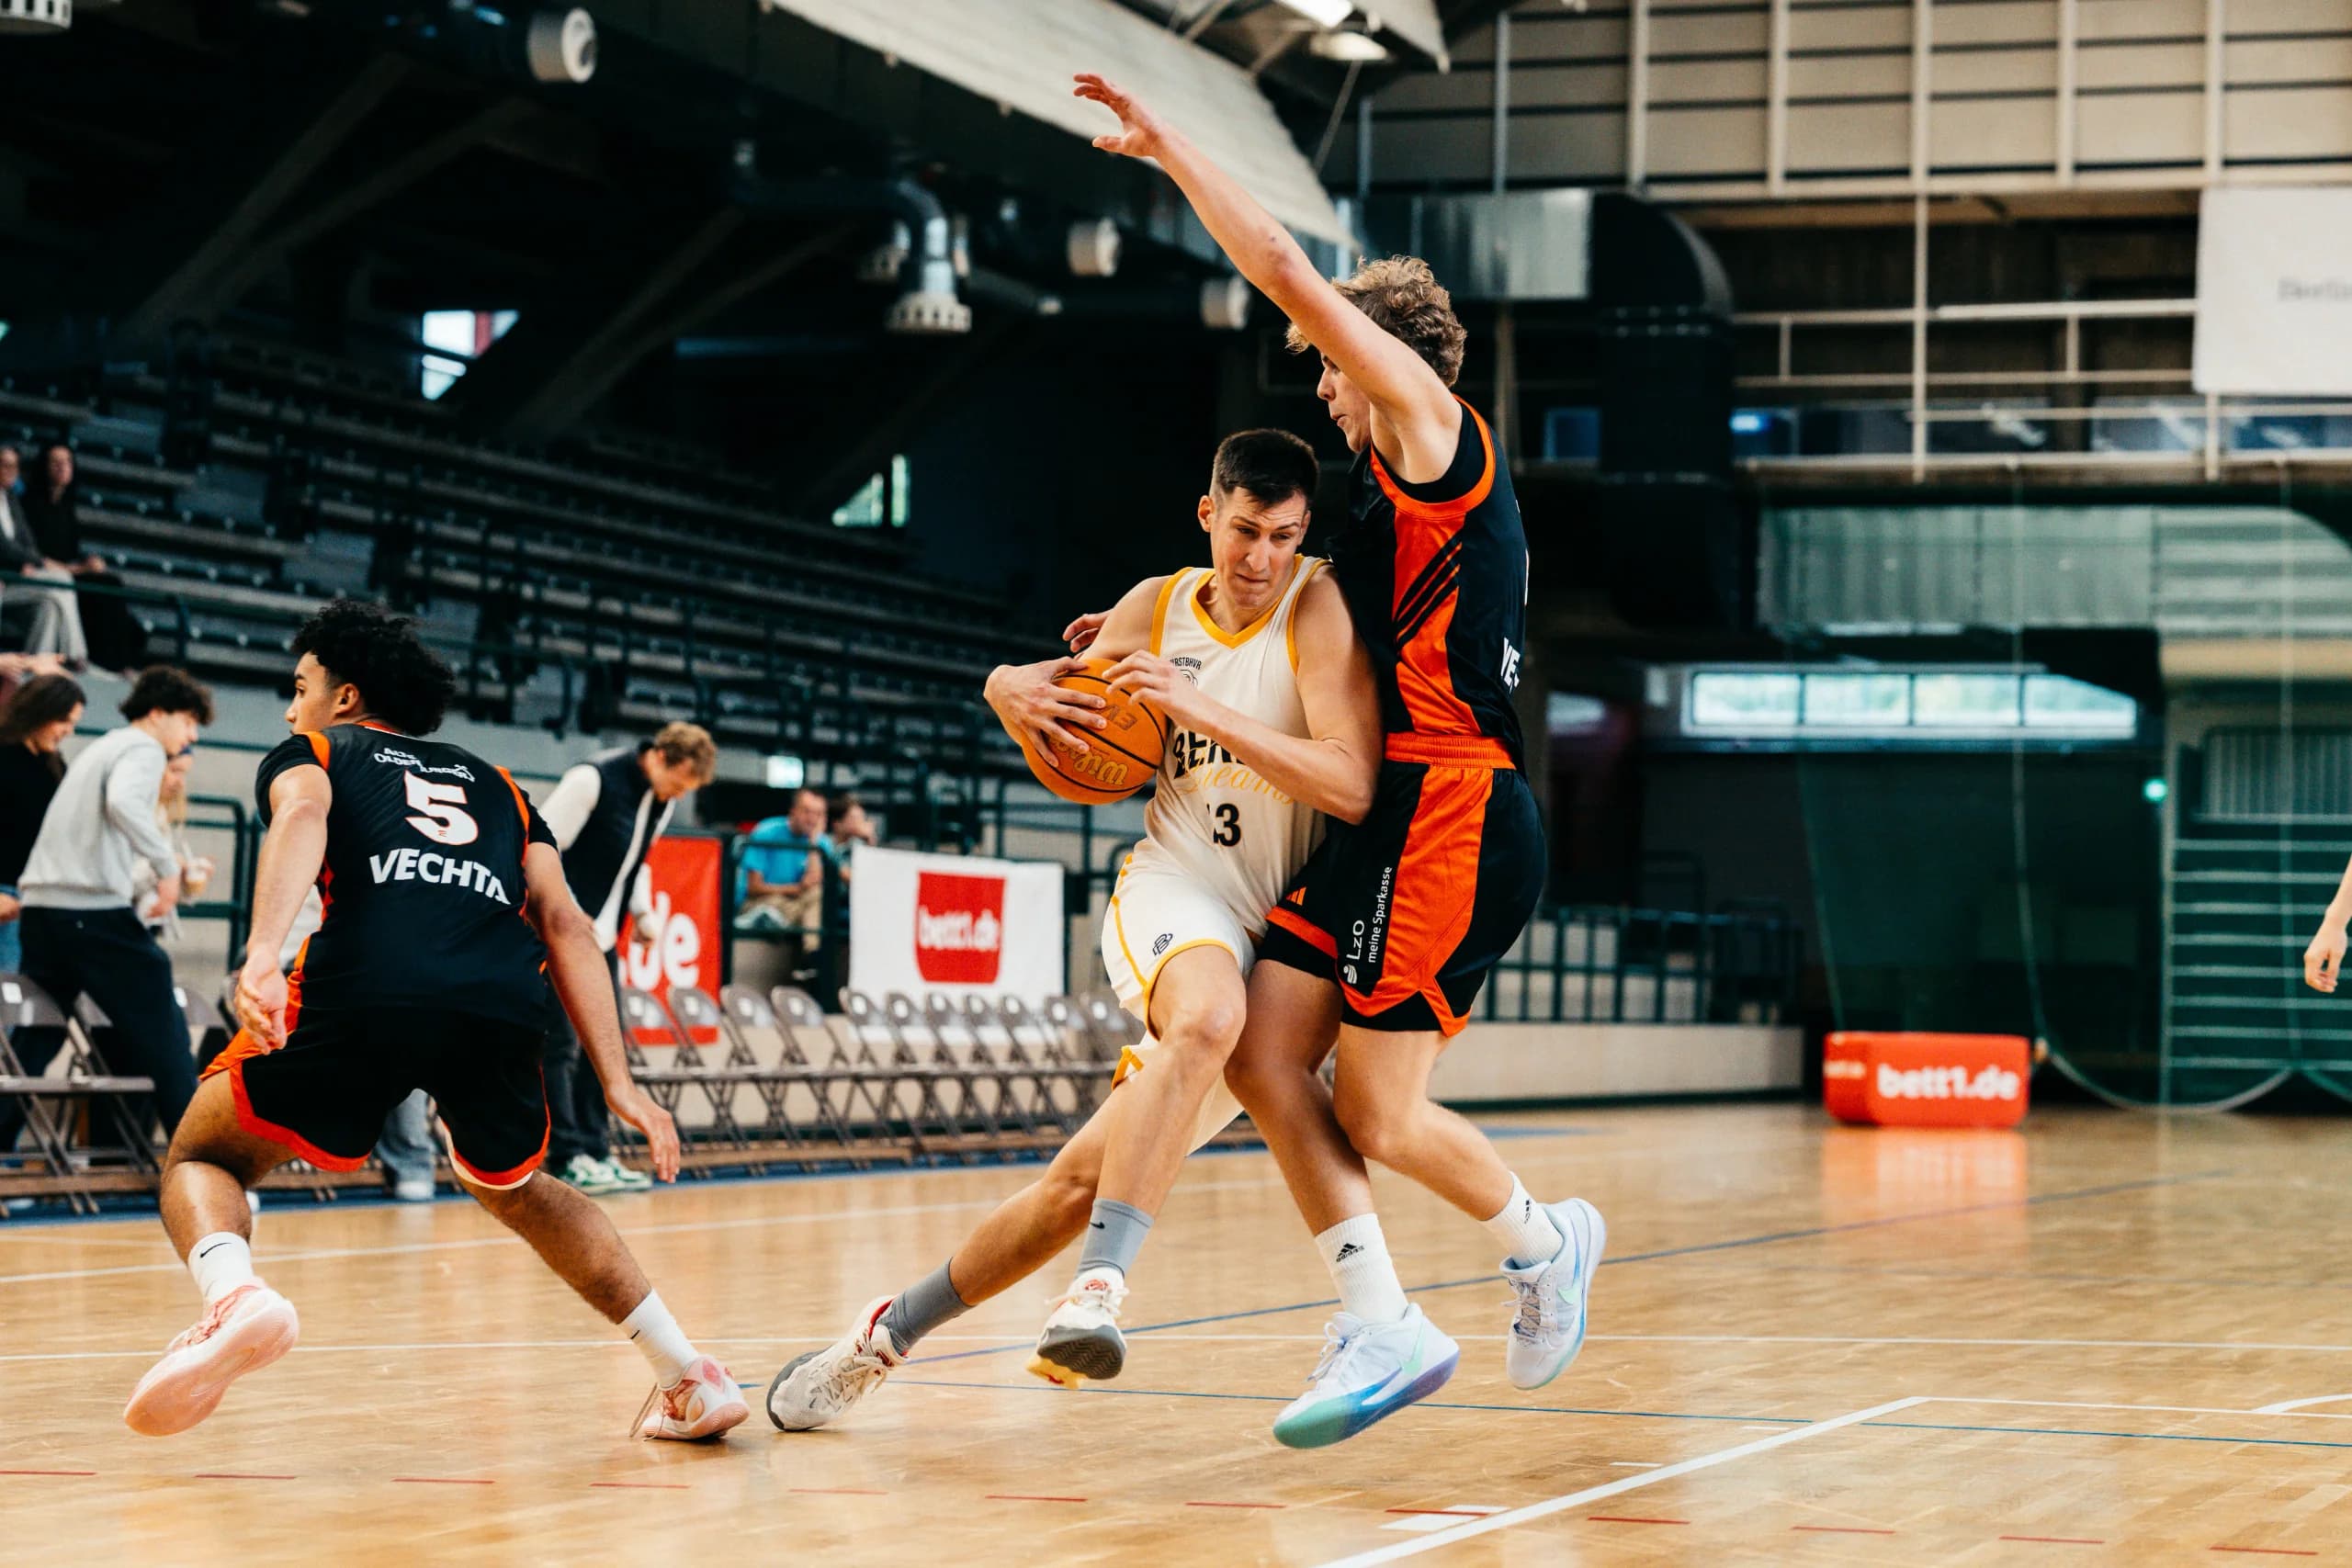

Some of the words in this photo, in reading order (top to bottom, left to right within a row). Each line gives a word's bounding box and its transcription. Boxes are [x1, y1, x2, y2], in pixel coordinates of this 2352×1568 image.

[404, 769, 479, 845] 5
[1206, 803, 1241, 847] 3
[369, 848, 511, 905] VECHTA
[1373, 866, 1392, 924] Sparkasse
[1368, 926, 1381, 963] meine
[1877, 1064, 2020, 1100] bett1.de
